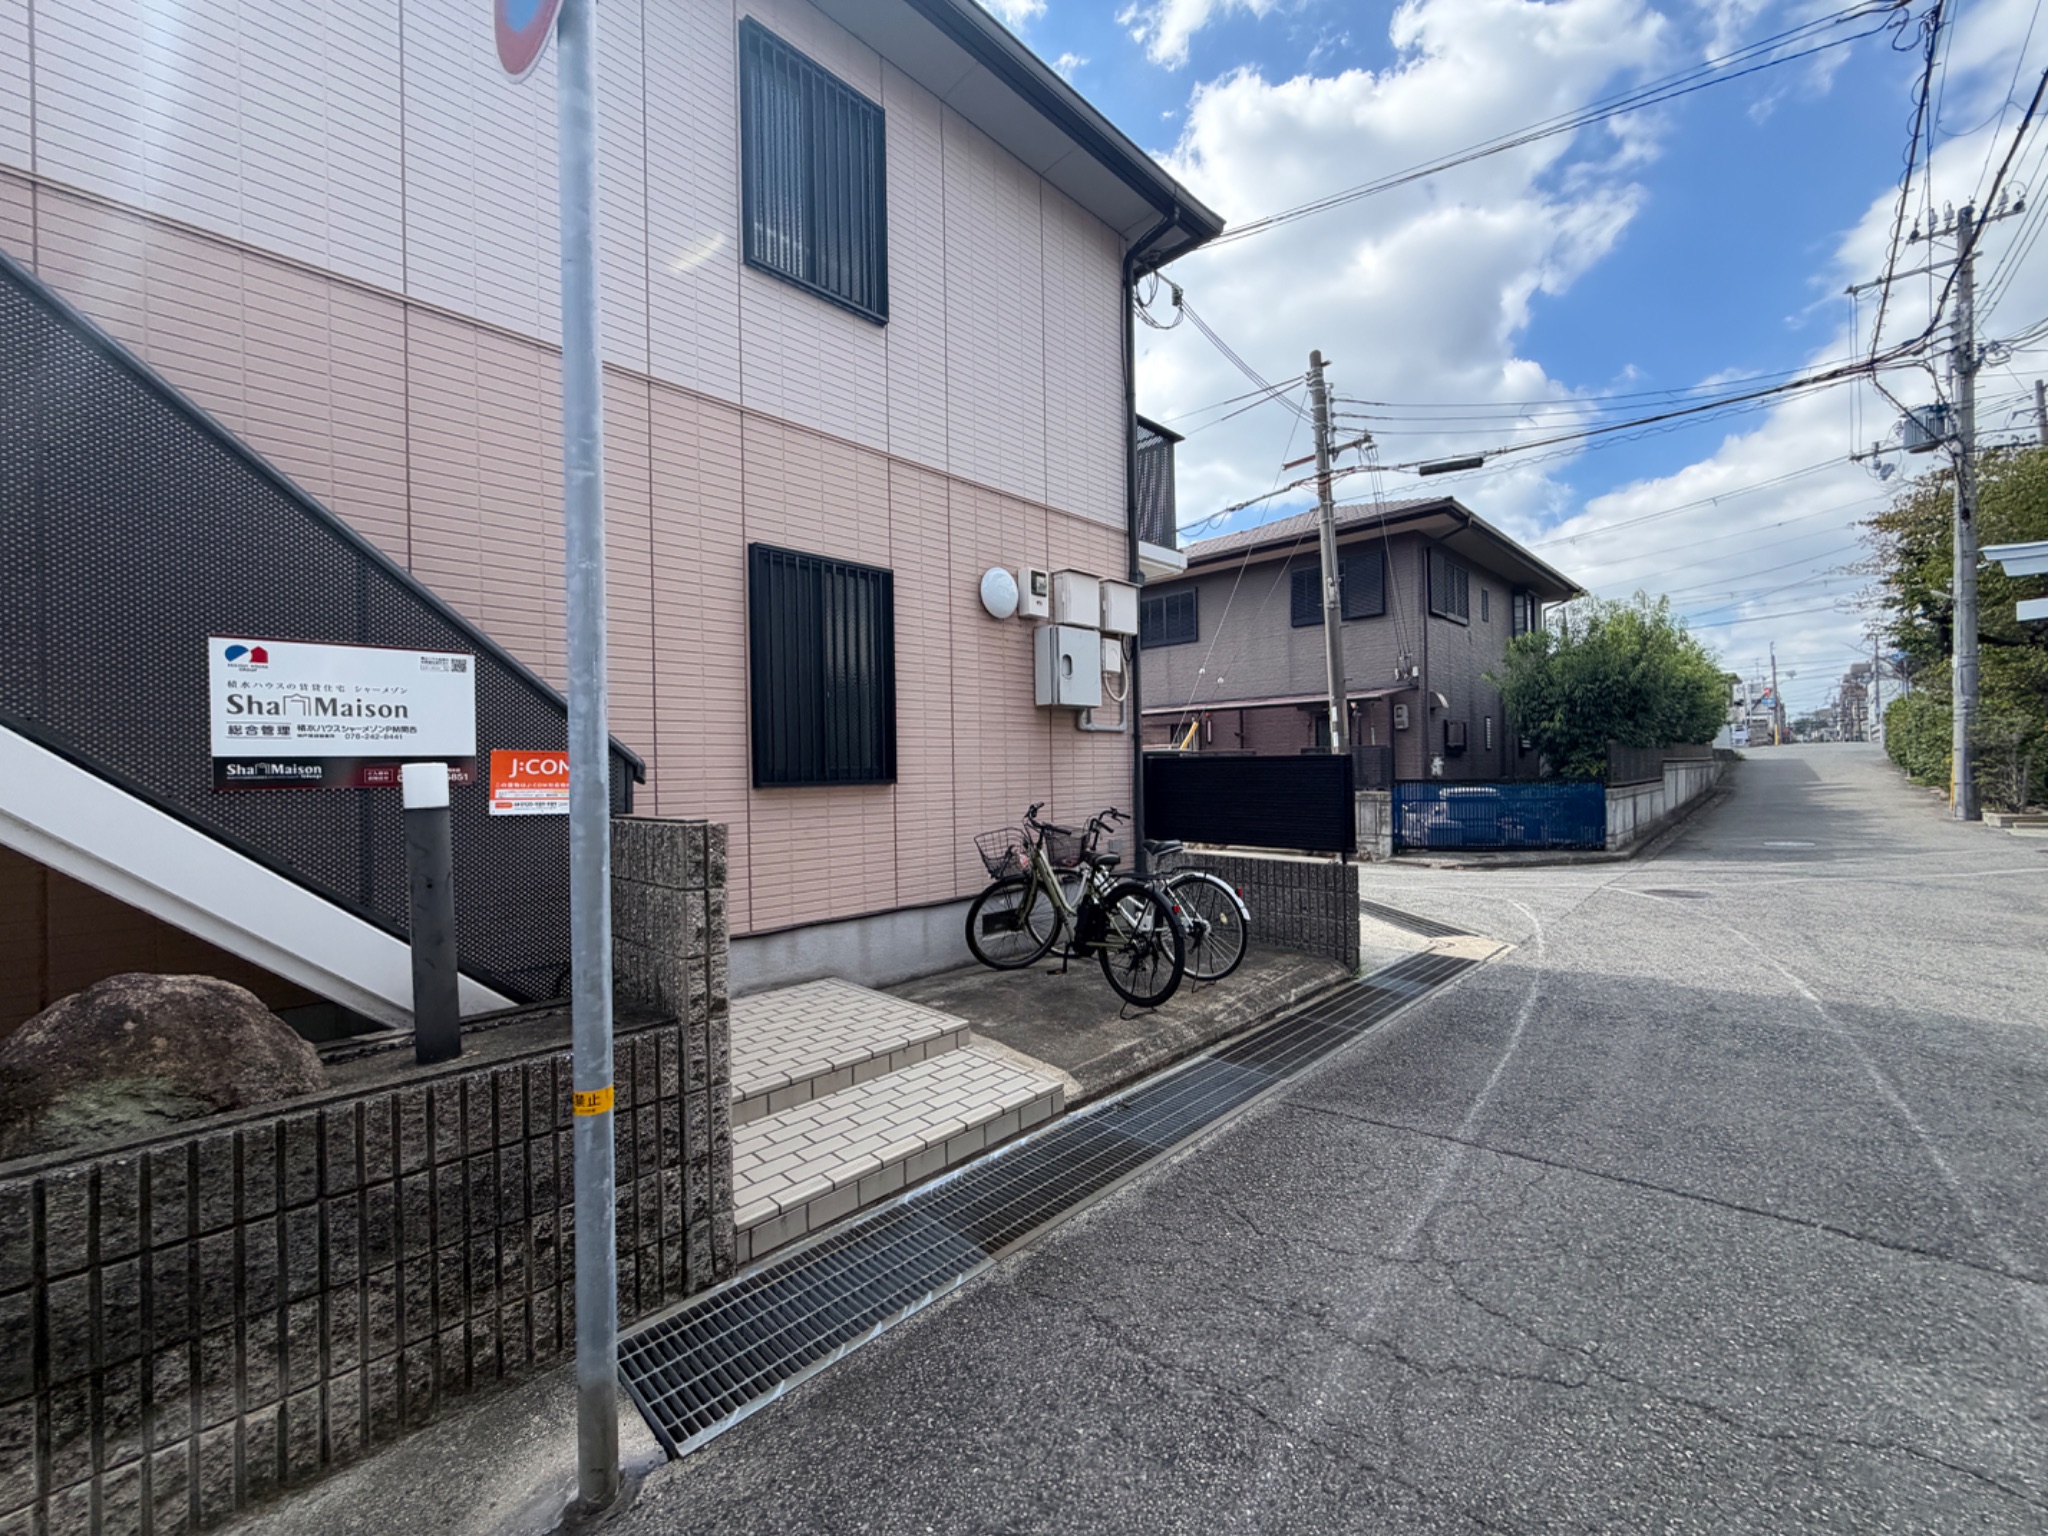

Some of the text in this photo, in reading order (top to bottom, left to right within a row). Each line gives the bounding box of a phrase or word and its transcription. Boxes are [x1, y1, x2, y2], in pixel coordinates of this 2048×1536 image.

[226, 679, 409, 695] 積水ハウスの賃貸住宅 シャーメゾン
[226, 693, 409, 719] Sha Maison
[227, 724, 291, 736] 総合管理
[226, 763, 323, 775] Sha Maison
